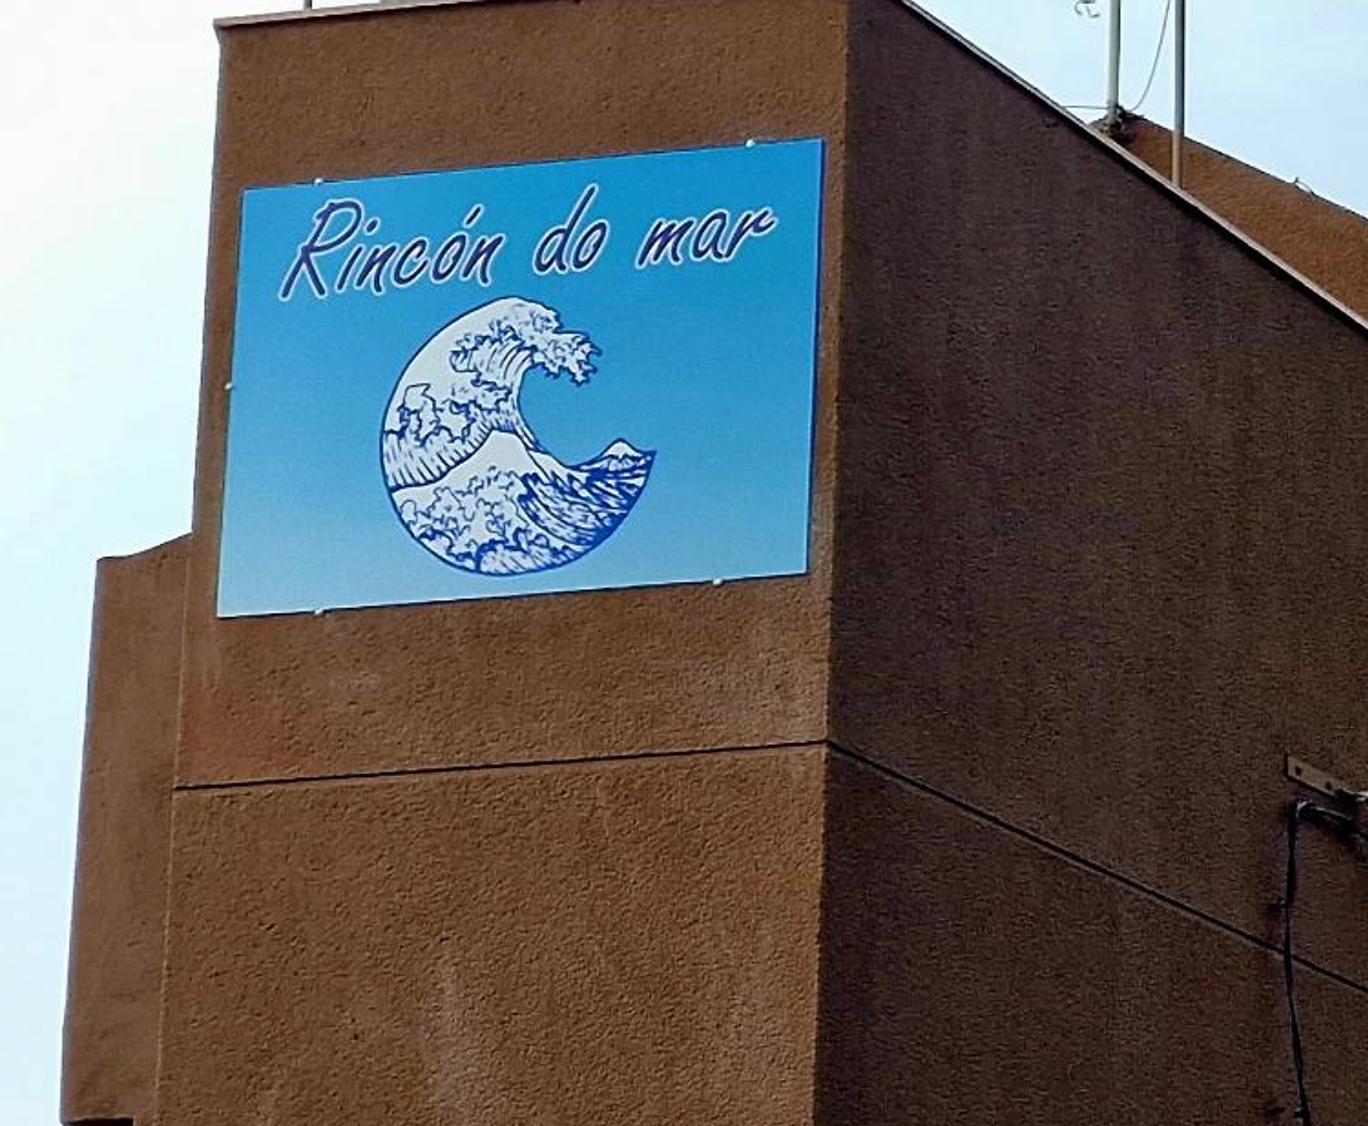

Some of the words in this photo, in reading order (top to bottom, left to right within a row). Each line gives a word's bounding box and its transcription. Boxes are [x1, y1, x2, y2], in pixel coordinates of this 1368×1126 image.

[277, 198, 507, 301] Rincón
[533, 182, 610, 276] do
[637, 205, 778, 270] mar
